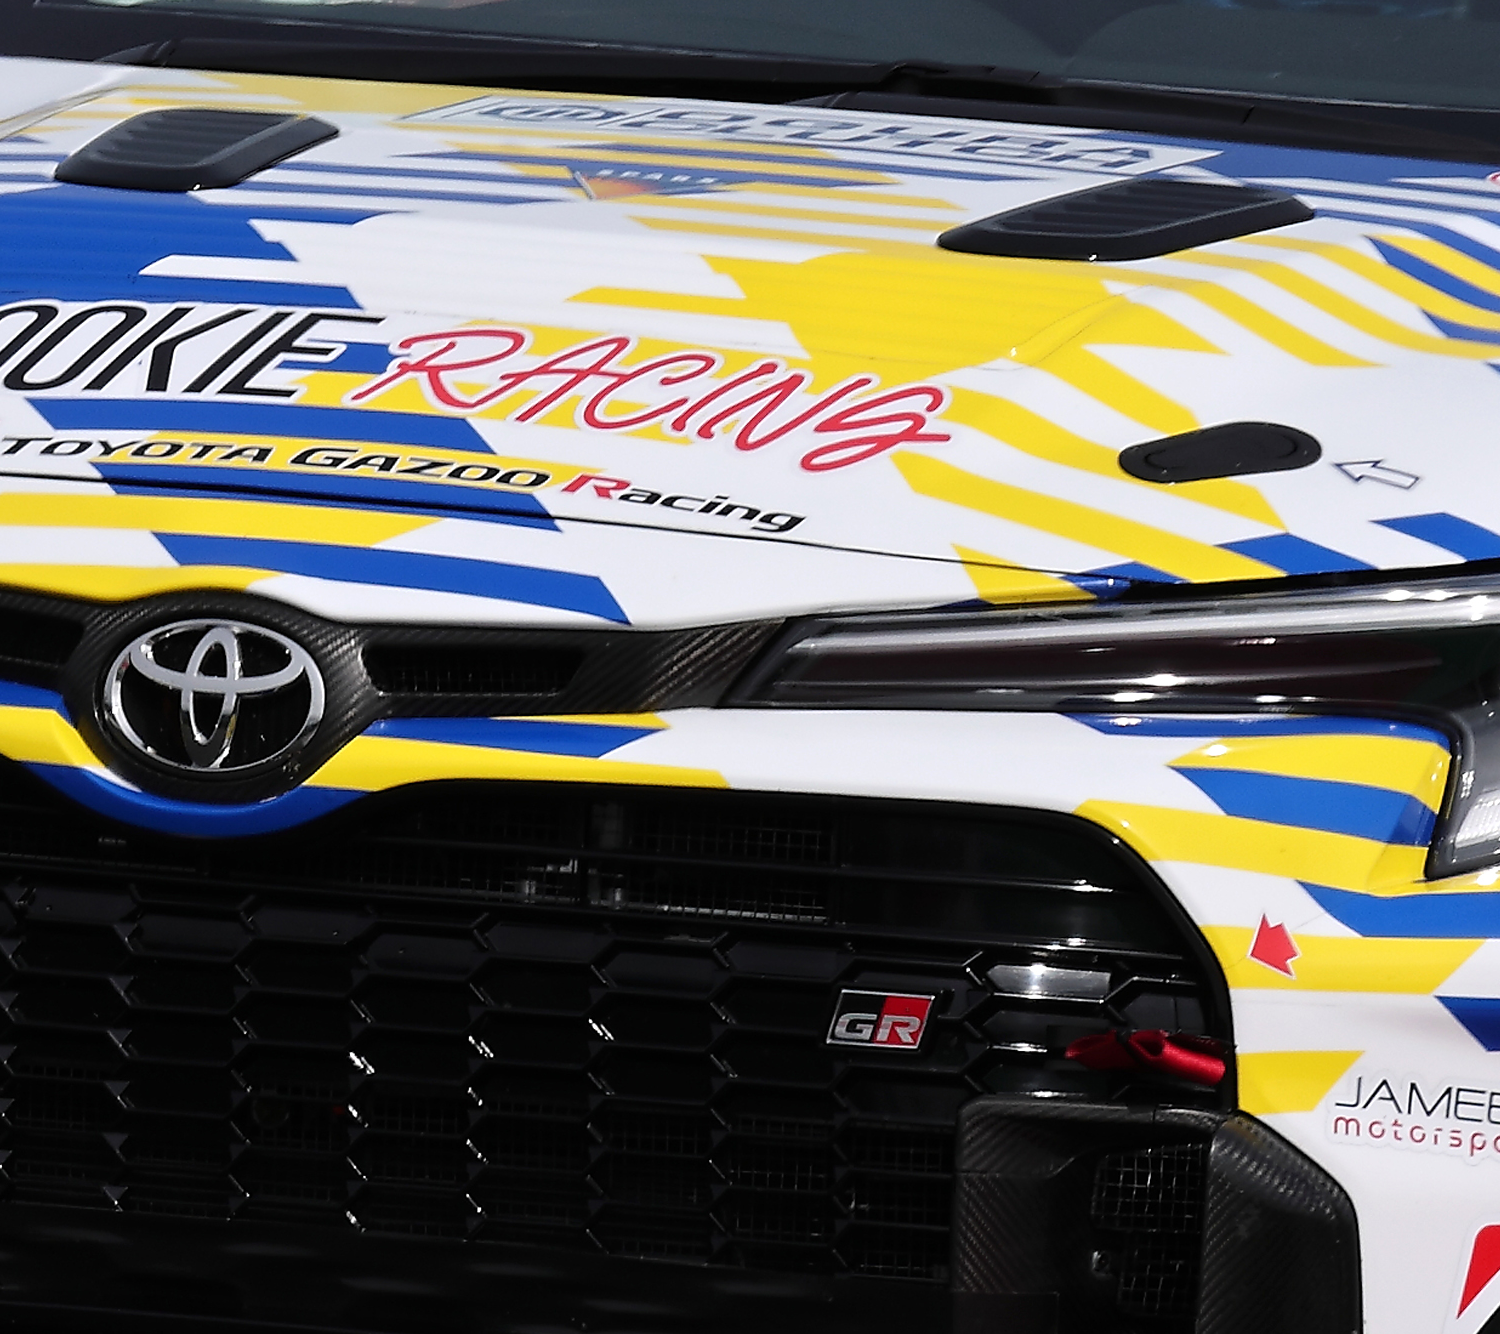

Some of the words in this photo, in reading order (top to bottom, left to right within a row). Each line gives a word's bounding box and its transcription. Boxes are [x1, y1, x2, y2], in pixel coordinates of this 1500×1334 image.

[351, 326, 951, 472] RACING
[1, 435, 273, 467] TOYOTA
[290, 445, 552, 491] GAZOO
[560, 473, 808, 533] Racing
[832, 1011, 925, 1046] GR
